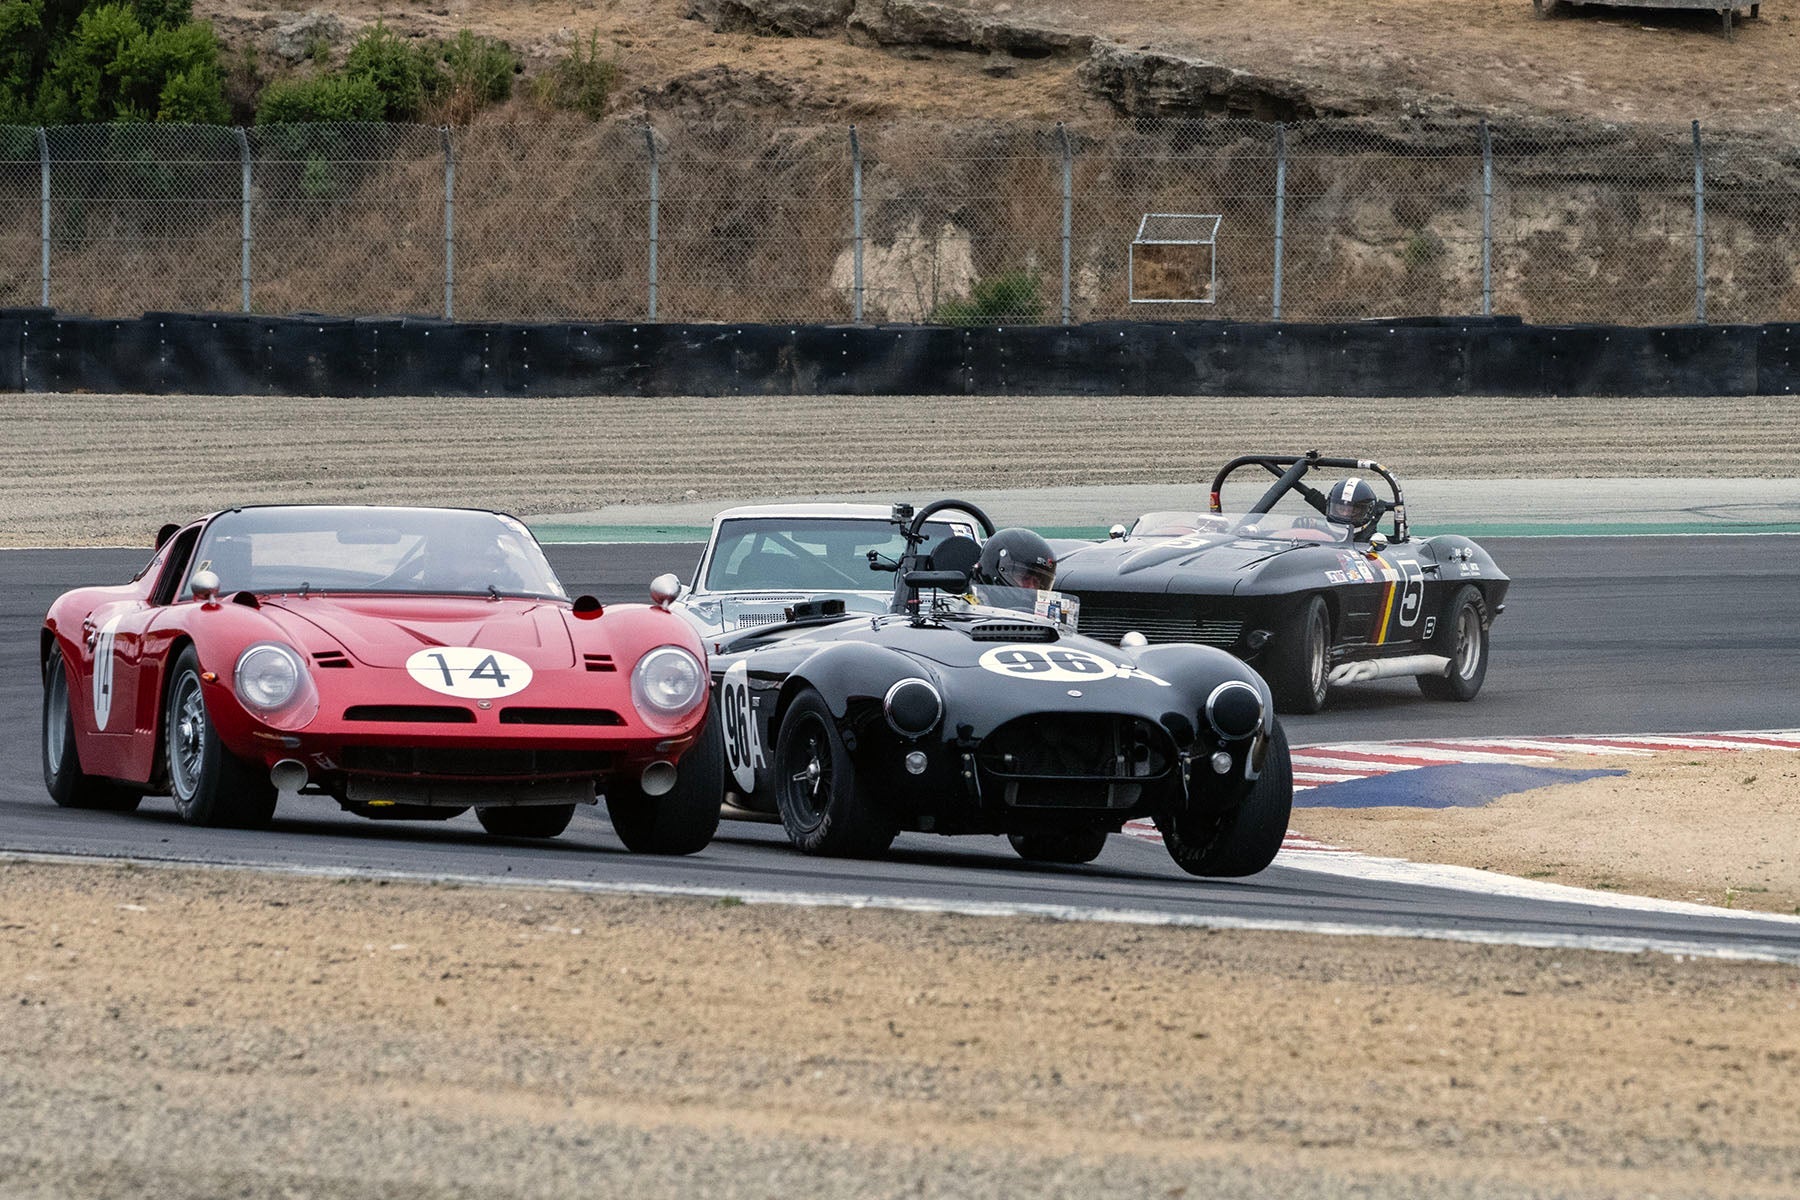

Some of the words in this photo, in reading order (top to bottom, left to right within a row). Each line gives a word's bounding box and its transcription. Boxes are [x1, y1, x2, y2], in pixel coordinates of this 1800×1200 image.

[1397, 560, 1424, 627] 5
[1422, 616, 1437, 639] B
[97, 632, 112, 711] 14
[426, 653, 511, 687] 14
[994, 650, 1104, 673] 96
[724, 683, 752, 768] 96
[751, 710, 767, 768] A
